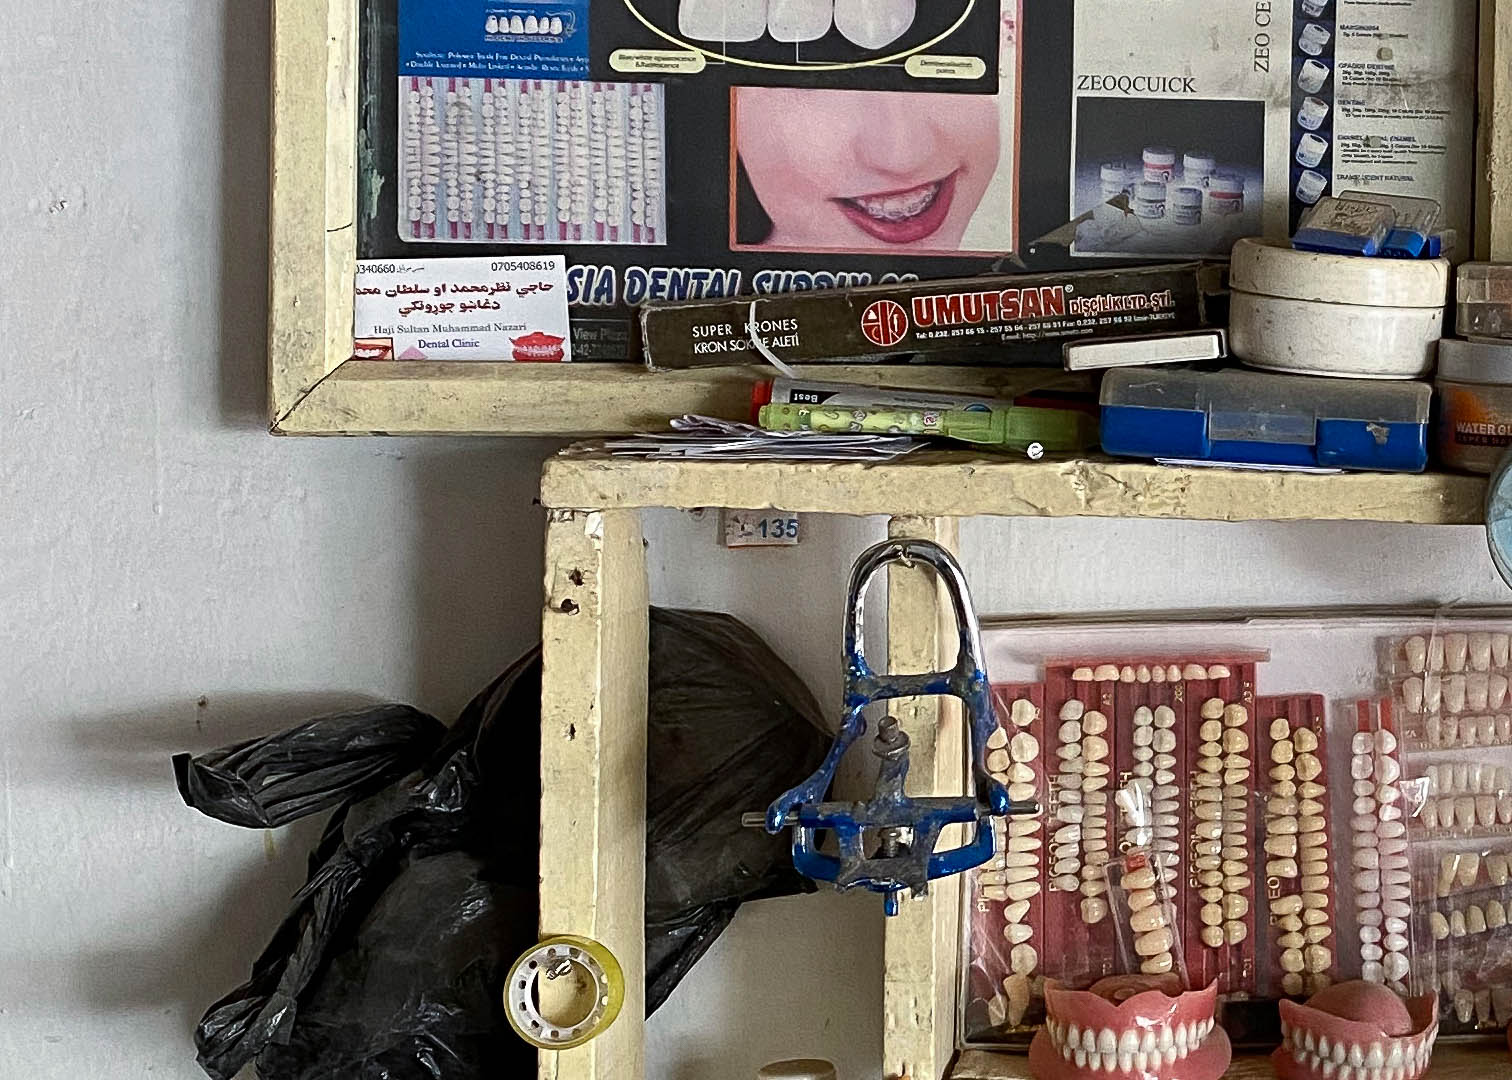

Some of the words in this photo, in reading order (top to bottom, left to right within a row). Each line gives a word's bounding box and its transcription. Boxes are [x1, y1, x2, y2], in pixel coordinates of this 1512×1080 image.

[1255, 1, 1271, 26] CE
[1254, 34, 1270, 73] ZEO
[1077, 75, 1197, 93] ZEOQCUICK
[491, 261, 554, 271] 0705408619
[912, 286, 1065, 328] UMUTSAN
[375, 326, 394, 334] Haji
[397, 324, 430, 334] Sultan
[433, 324, 490, 332] Muhammad
[494, 322, 527, 331] Nazari
[693, 324, 731, 338] SUPER
[744, 319, 798, 333] KRONES
[419, 340, 449, 349] Dental
[452, 338, 479, 348] Clinic
[694, 341, 726, 354] KRON
[760, 519, 799, 537] 135
